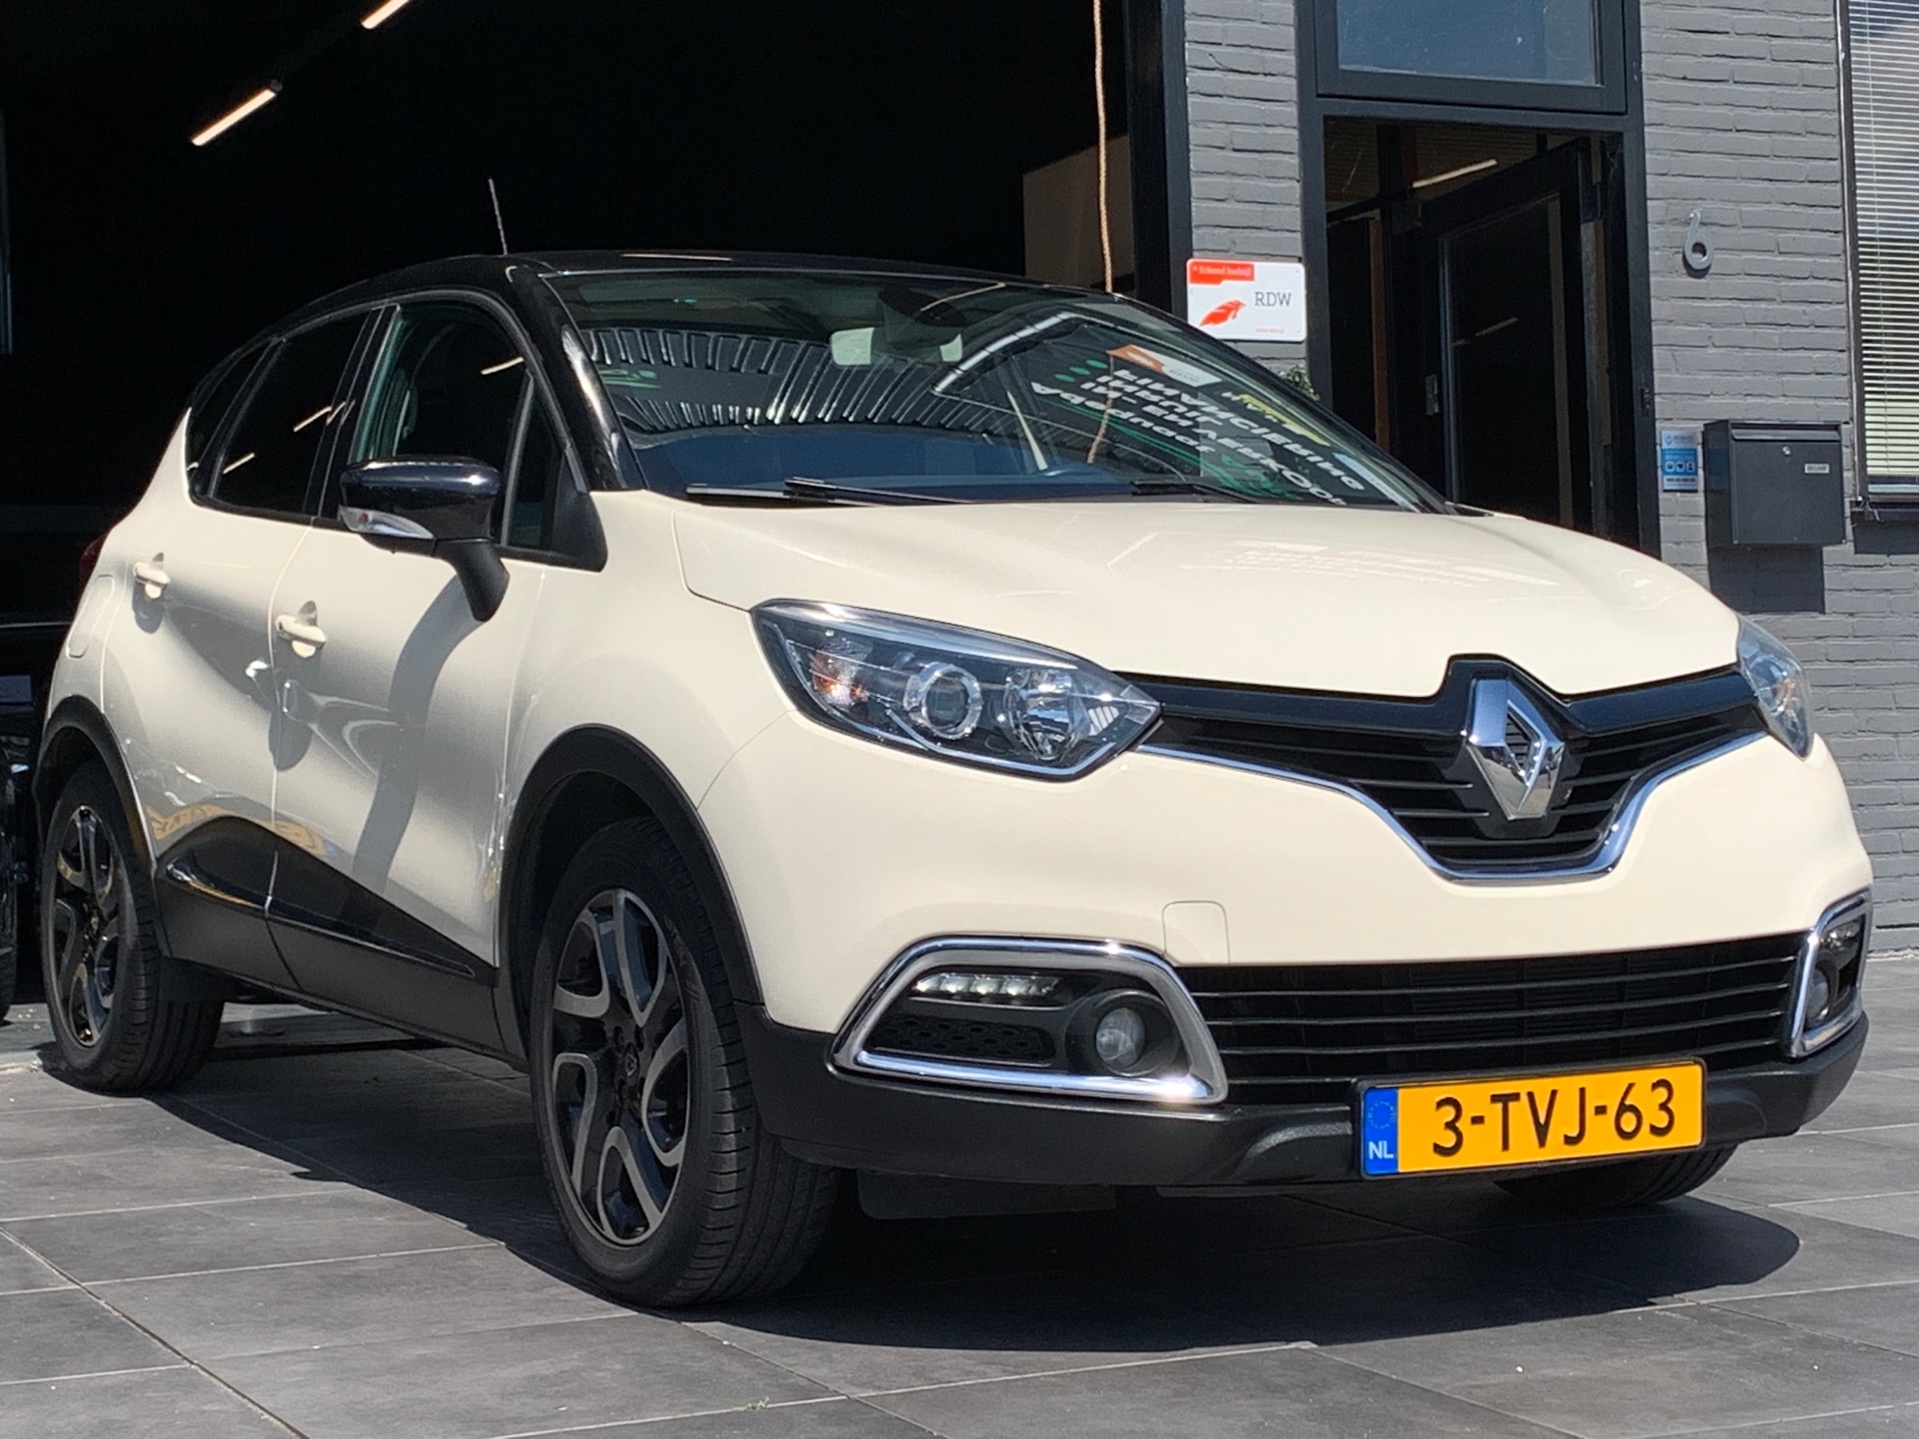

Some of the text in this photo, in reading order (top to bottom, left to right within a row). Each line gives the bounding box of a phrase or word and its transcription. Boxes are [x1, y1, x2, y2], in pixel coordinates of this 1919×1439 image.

[1684, 208, 1714, 270] 6
[1254, 291, 1292, 307] RDW
[1432, 1078, 1676, 1158] 3-TVJ-63
[1368, 1140, 1394, 1161] NL
